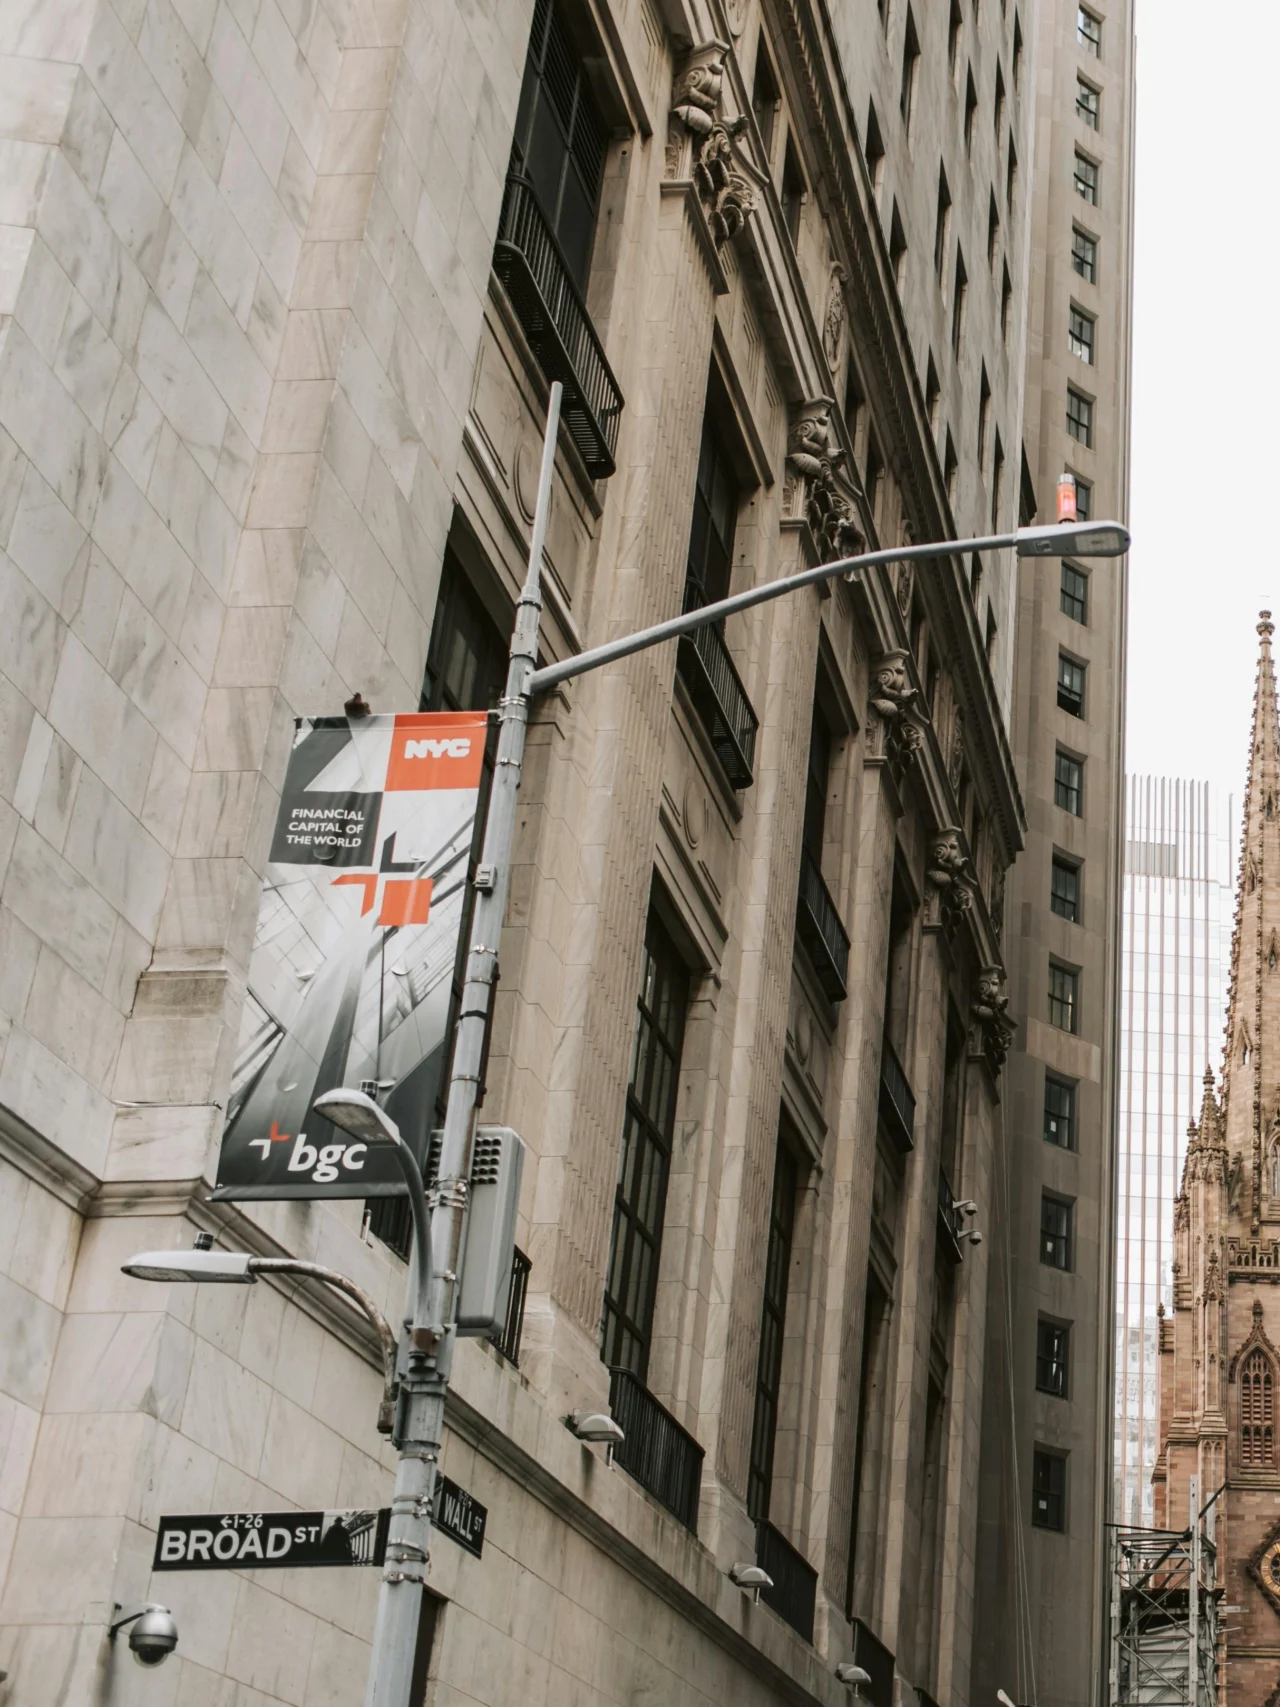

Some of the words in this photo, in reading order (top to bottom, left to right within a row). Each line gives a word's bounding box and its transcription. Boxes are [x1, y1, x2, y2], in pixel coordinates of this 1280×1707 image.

[404, 738, 471, 759] NYC
[291, 808, 365, 821] FINANCIAL
[288, 821, 343, 833] CAPITAL
[345, 824, 364, 834] OF
[286, 835, 312, 845] THE
[313, 835, 362, 848] WORLD
[287, 1133, 368, 1183] bgc
[233, 1514, 264, 1529] 1-26
[444, 1492, 473, 1541] WALL
[474, 1515, 482, 1533] ST
[160, 1527, 293, 1561] BROAD
[294, 1526, 320, 1544] ST
